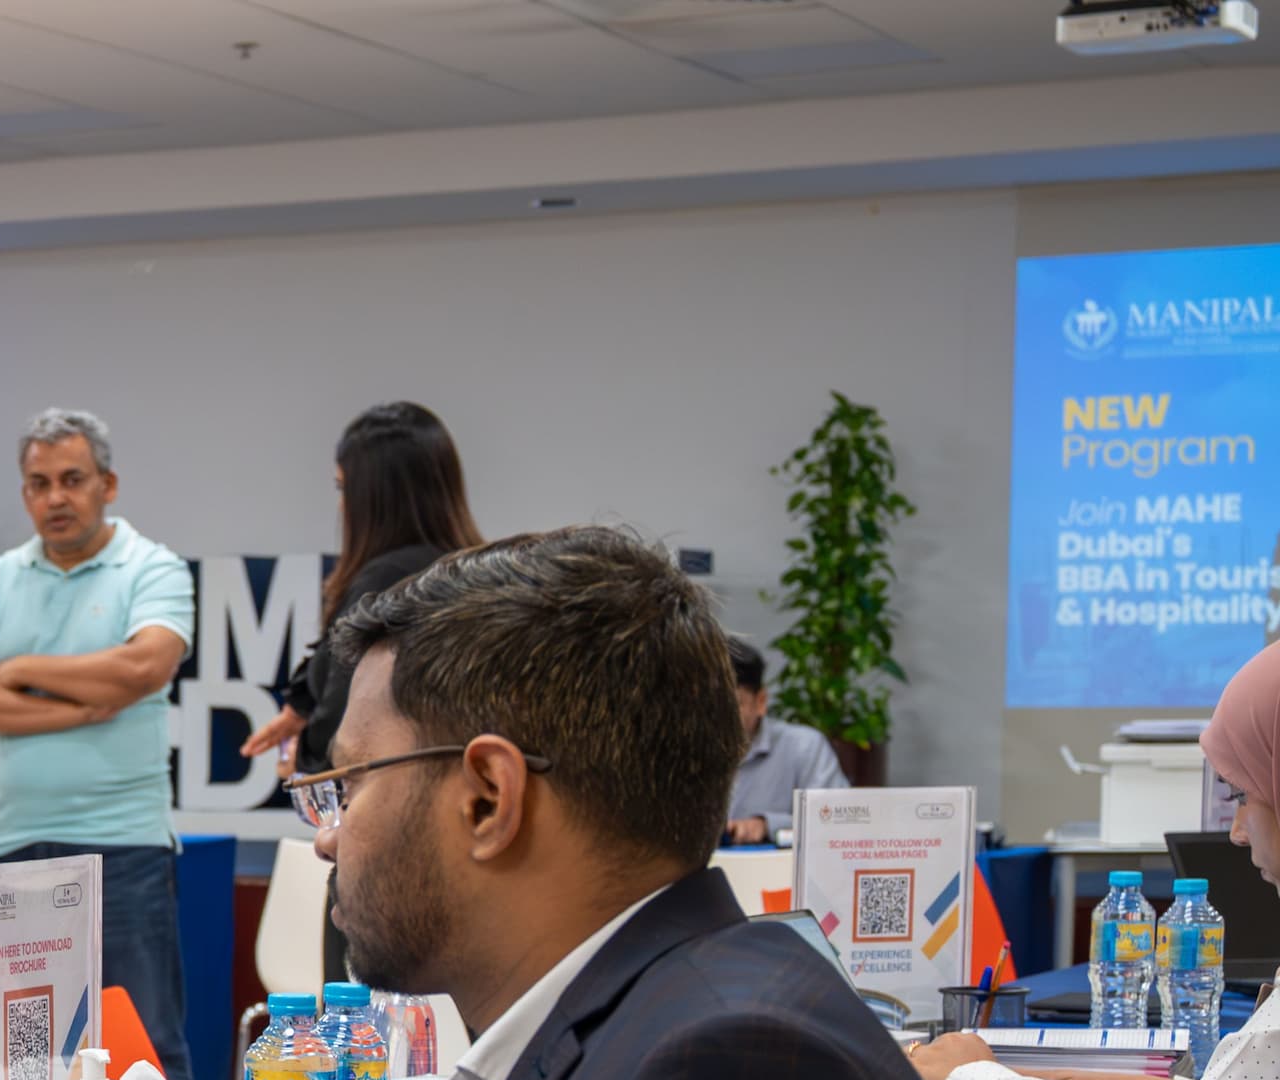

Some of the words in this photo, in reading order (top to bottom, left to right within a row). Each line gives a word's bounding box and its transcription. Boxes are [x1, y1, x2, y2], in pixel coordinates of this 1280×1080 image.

[1127, 296, 1280, 327] MANIPAL
[1063, 394, 1171, 431] NEW
[1062, 434, 1255, 478] Program
[1057, 497, 1127, 527] Join
[1135, 492, 1243, 524] MAHE
[1057, 525, 1192, 560] Dubai's
[1057, 564, 1130, 593] BBA
[1135, 559, 1170, 591] in
[1056, 598, 1084, 626] &
[1090, 593, 1280, 634] Hospitality
[841, 849, 872, 860] SOCIAL
[873, 849, 900, 859] MEDIA
[877, 839, 888, 848] TO
[889, 837, 923, 848] FOLLOW
[924, 837, 942, 847] OUR
[4, 942, 21, 959] HERE
[22, 941, 32, 956] TO
[32, 936, 72, 955] DOWNLOAD
[9, 957, 46, 975] BROCHURE
